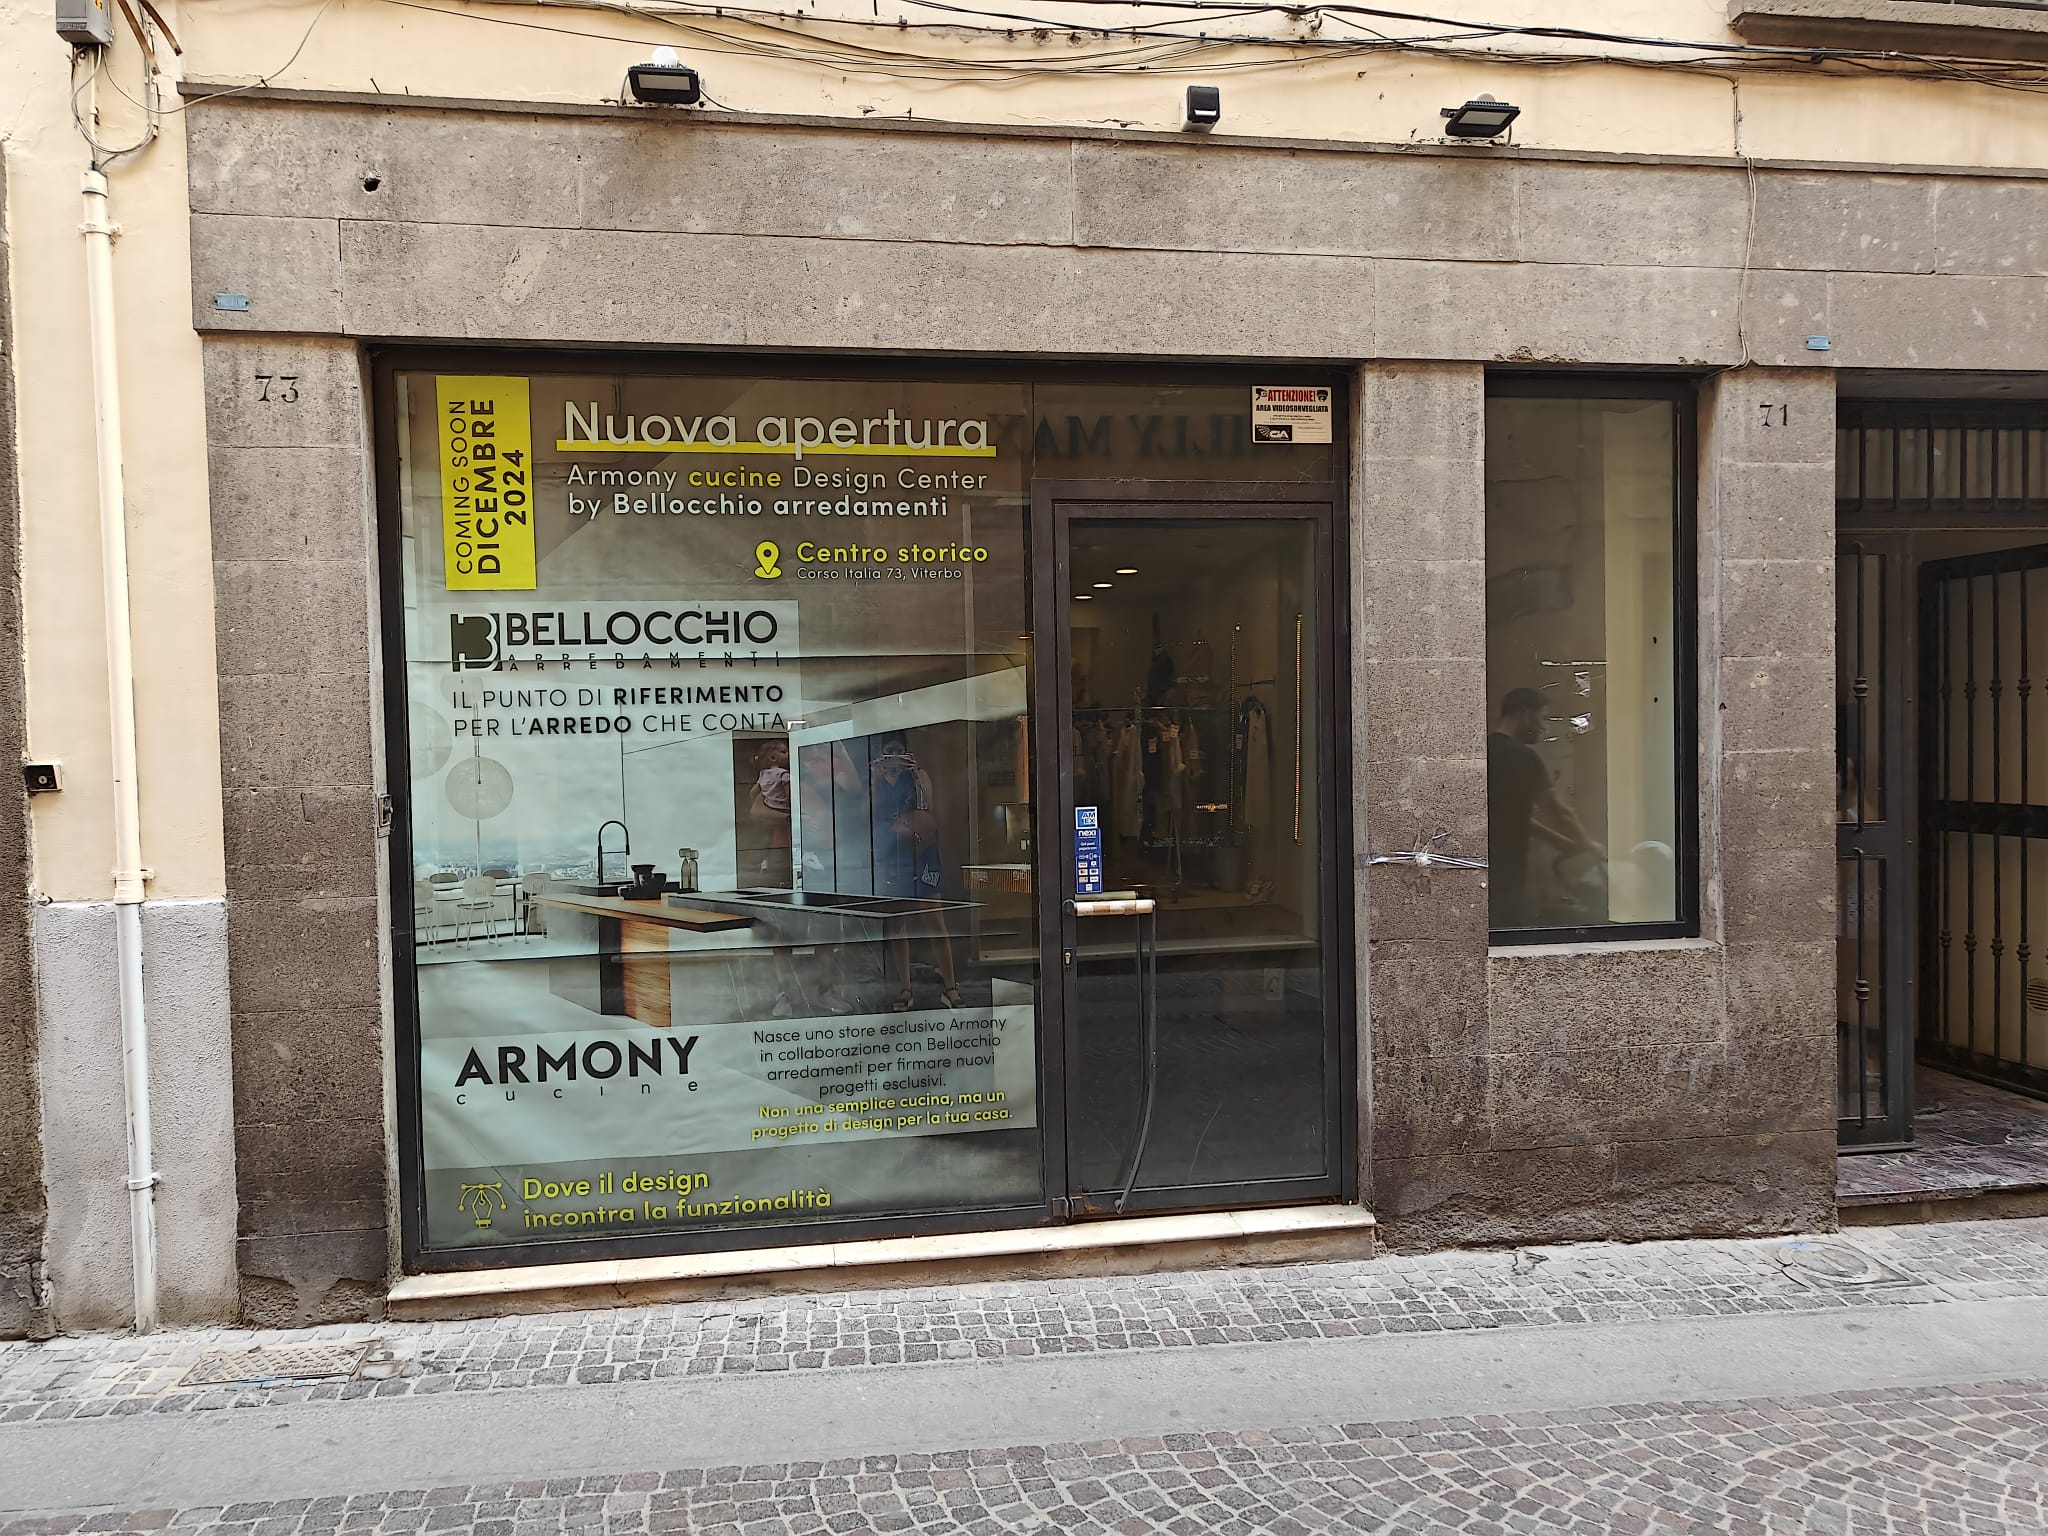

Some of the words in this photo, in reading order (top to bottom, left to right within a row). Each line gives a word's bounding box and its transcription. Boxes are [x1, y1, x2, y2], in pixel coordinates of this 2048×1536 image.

[255, 375, 299, 403] 73
[1268, 390, 1316, 402] ATTENZIONE!
[1256, 404, 1272, 412] AREA
[1760, 404, 1788, 428] 71
[448, 400, 469, 468] SOON
[565, 401, 737, 446] Nuova
[756, 408, 988, 460] apertura
[470, 400, 501, 574] DICEMBRE
[502, 450, 527, 526] 2024
[566, 464, 677, 492] Armony
[688, 466, 782, 488] cucine
[793, 466, 886, 494] Design
[897, 468, 988, 490] Center
[569, 492, 601, 520] by
[614, 493, 762, 516] Bellocchio
[773, 495, 948, 517] arredamenti
[453, 476, 474, 575] COMING
[796, 542, 889, 562] Centro
[897, 542, 989, 562] storico
[796, 568, 839, 580] Corso
[845, 568, 882, 580] Italia
[886, 568, 906, 582] 73,
[911, 567, 962, 580] Viterbo
[506, 610, 778, 646] BELLOCCHIO
[509, 651, 780, 672] ARREDAMENTI
[453, 690, 472, 709] IL
[483, 688, 567, 708] PUNTO
[578, 688, 602, 707] DI
[614, 684, 784, 706] RIFERIMENTO
[454, 718, 499, 737] PER
[642, 714, 692, 733] CHE
[702, 712, 786, 732] CONTA
[754, 1030, 800, 1044] Nasce
[805, 1028, 834, 1041] uno
[838, 1025, 875, 1039] store
[880, 1019, 946, 1036] esclusivo
[950, 1016, 1007, 1033] Armony
[455, 1035, 700, 1087] ARMONY
[760, 1050, 773, 1062] in
[778, 1042, 891, 1062] collaborazione
[895, 1040, 922, 1053] con
[927, 1034, 1002, 1051] Bellocchio
[767, 1061, 862, 1081] arredamenti
[868, 1060, 890, 1076] per
[897, 1056, 951, 1072] firmare
[956, 1052, 995, 1068] nuovi
[456, 1080, 698, 1106] cucine
[819, 1078, 878, 1098] progetti
[882, 1075, 946, 1092] esclusivi.
[759, 1106, 790, 1120] Non
[794, 1103, 824, 1117] una
[828, 1096, 896, 1114] semplice
[900, 1092, 954, 1109] cucina,
[958, 1092, 982, 1104] ma
[987, 1090, 1006, 1103] un
[751, 1120, 819, 1142] progetto
[824, 1118, 838, 1133] di
[842, 1115, 894, 1133] design
[896, 1114, 922, 1131] per
[926, 1111, 941, 1125] la
[945, 1110, 970, 1124] tua
[974, 1108, 1013, 1122] casa.
[524, 1176, 590, 1200] Dove
[599, 1172, 614, 1195] il
[622, 1170, 709, 1196] design
[524, 1206, 635, 1229] incontra
[644, 1202, 667, 1222] la
[676, 1188, 832, 1219] funzionalità
